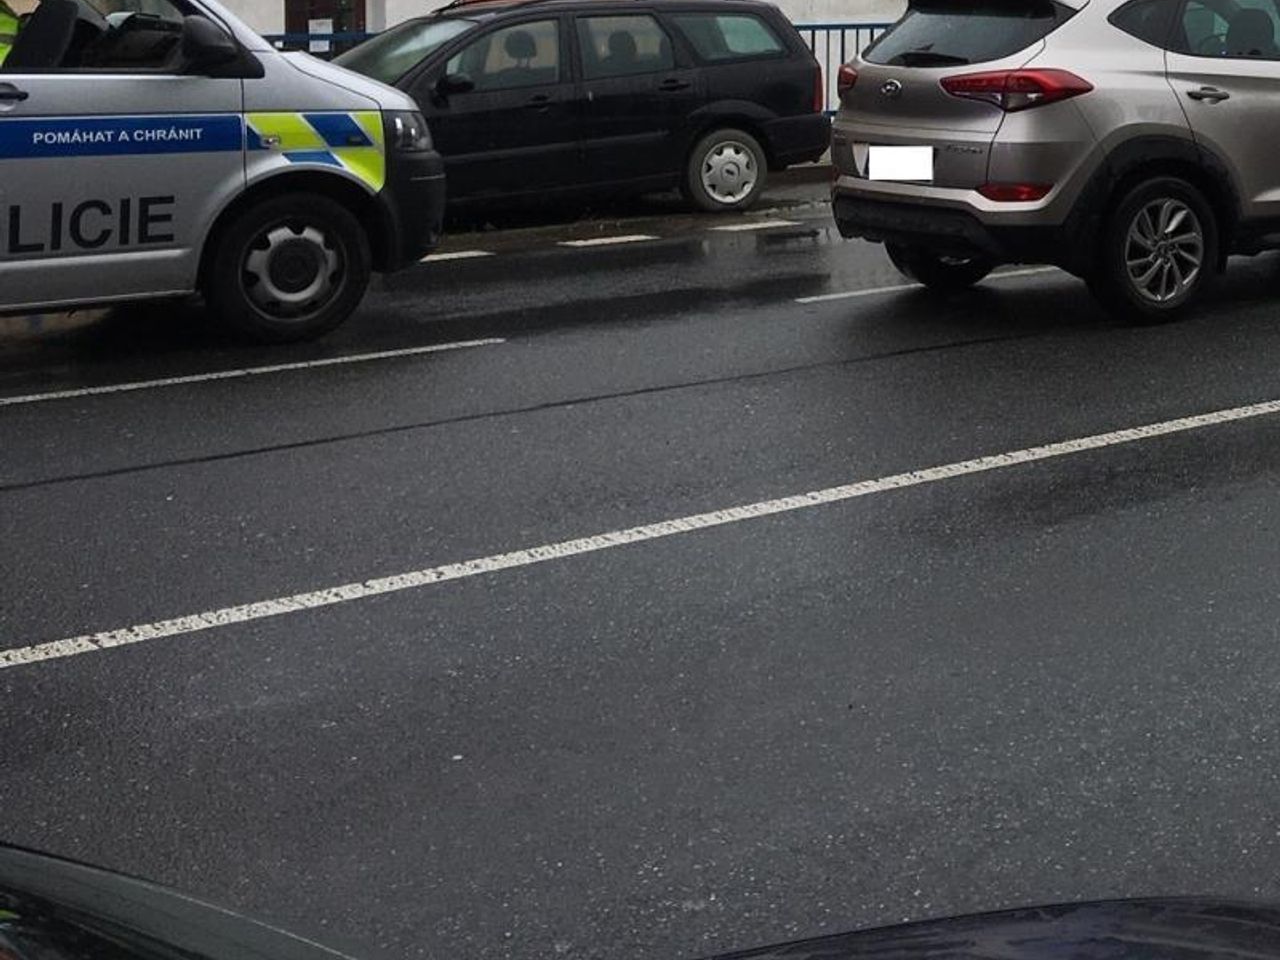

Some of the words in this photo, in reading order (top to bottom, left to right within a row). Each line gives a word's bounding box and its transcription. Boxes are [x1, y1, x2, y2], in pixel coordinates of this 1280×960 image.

[33, 129, 115, 144] POMÁHAT
[118, 131, 130, 142] A
[134, 126, 204, 141] CHRÁNIT
